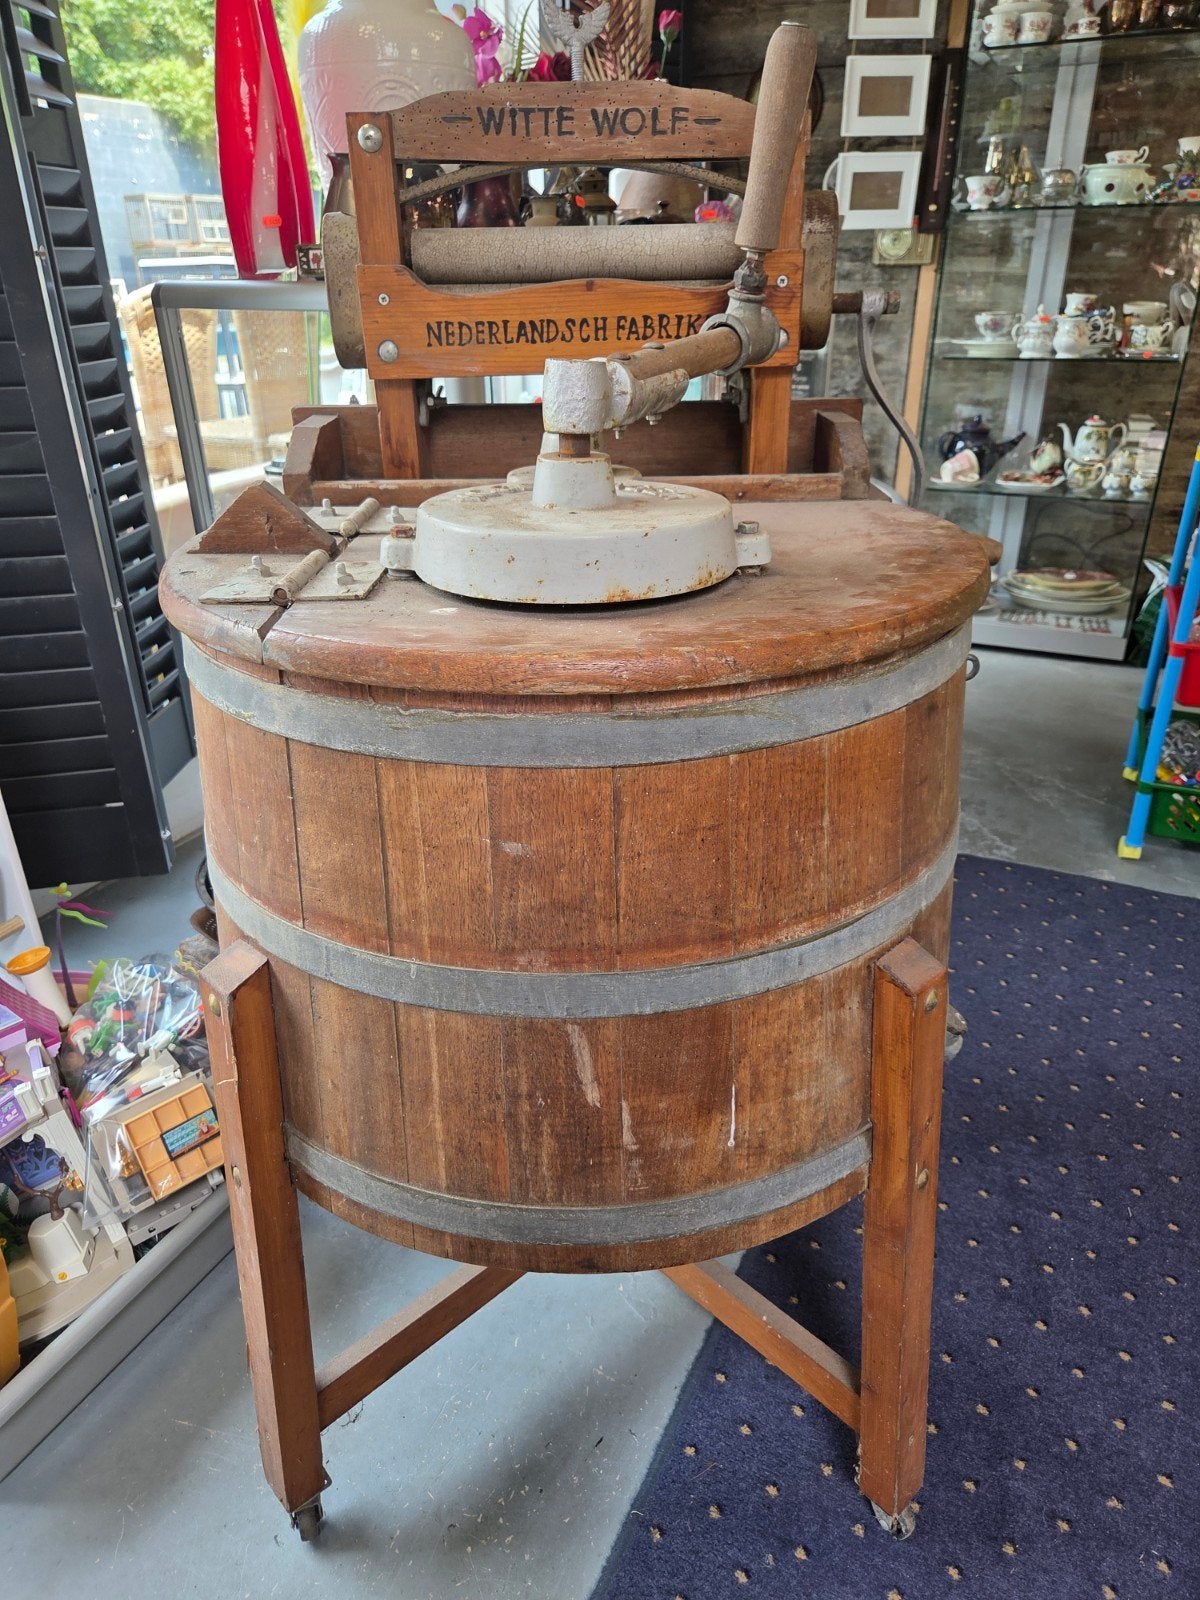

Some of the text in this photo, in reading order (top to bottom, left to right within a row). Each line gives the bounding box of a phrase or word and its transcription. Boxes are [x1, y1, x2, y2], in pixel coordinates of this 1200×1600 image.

[476, 106, 689, 137] WITTE WOLF
[426, 313, 711, 347] NEDERLANDSCH FABRIK
